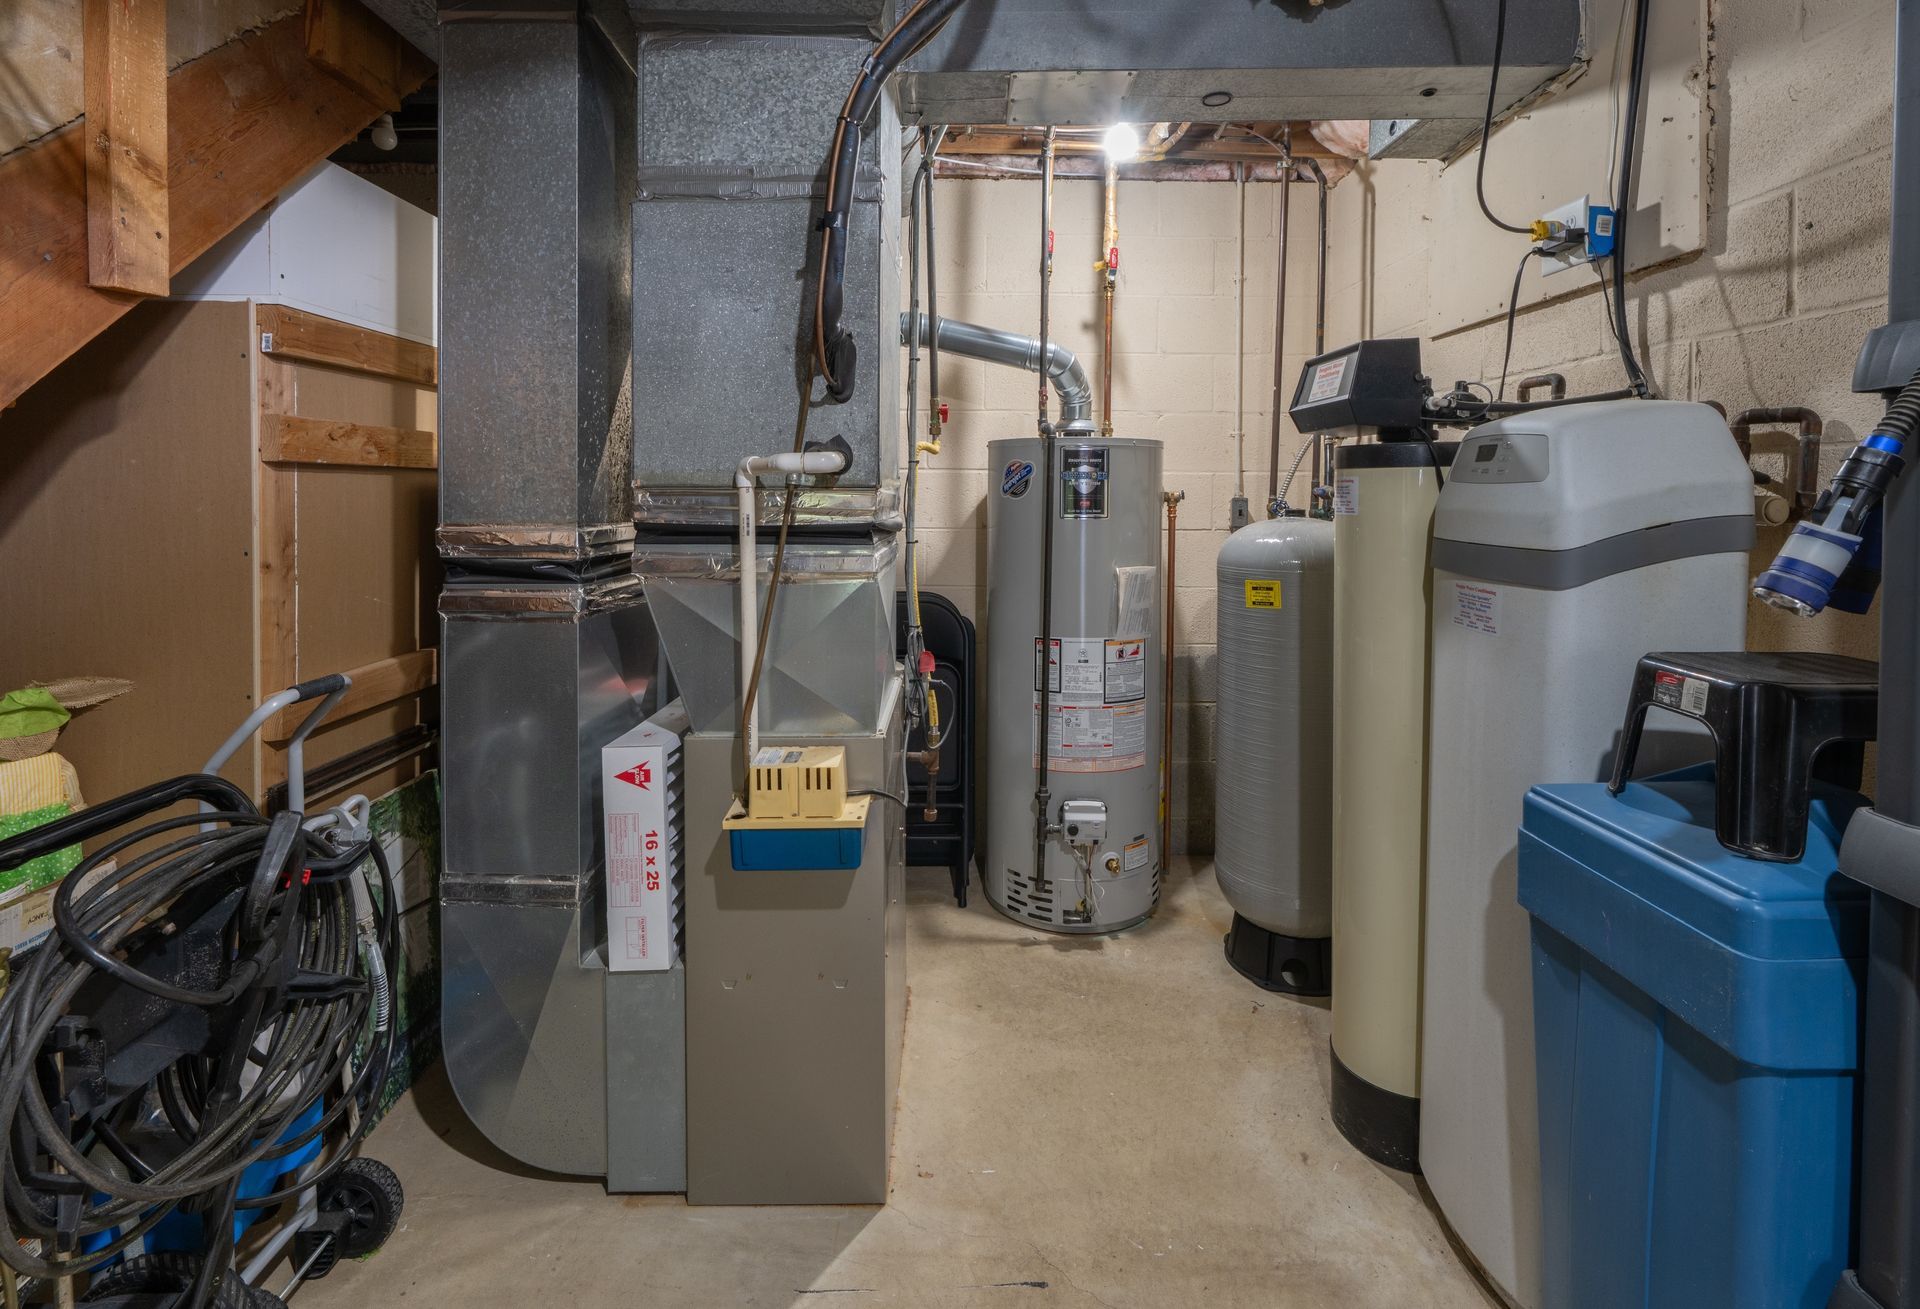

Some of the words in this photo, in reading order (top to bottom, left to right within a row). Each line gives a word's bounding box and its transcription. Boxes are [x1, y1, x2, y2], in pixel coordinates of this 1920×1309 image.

[645, 830, 659, 850] 16
[646, 855, 657, 866] x
[646, 871, 660, 891] 25
